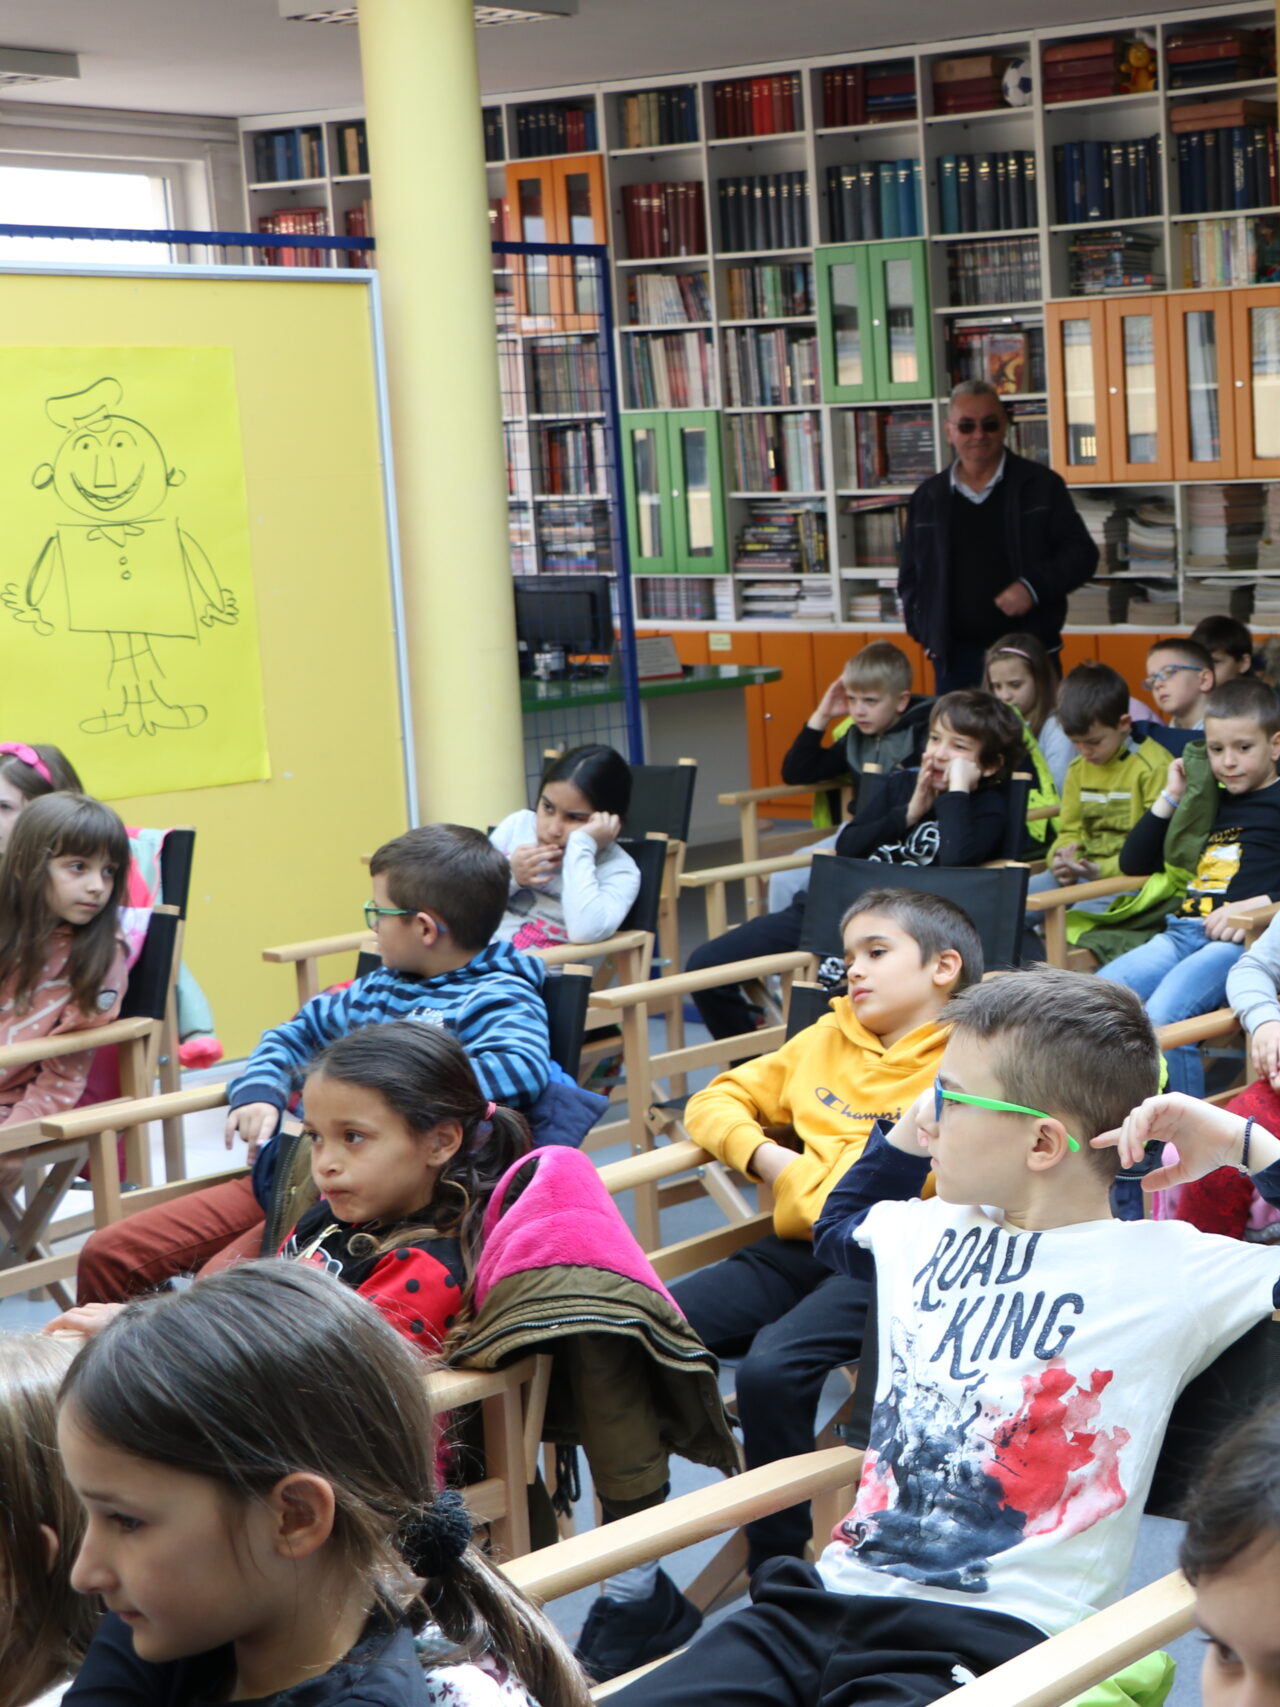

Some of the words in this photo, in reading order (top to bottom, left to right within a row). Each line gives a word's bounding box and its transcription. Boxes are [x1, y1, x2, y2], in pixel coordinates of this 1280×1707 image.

[815, 1087, 902, 1121] Champi
[912, 1227, 1041, 1312] ROAD
[931, 1290, 1085, 1381] KING
